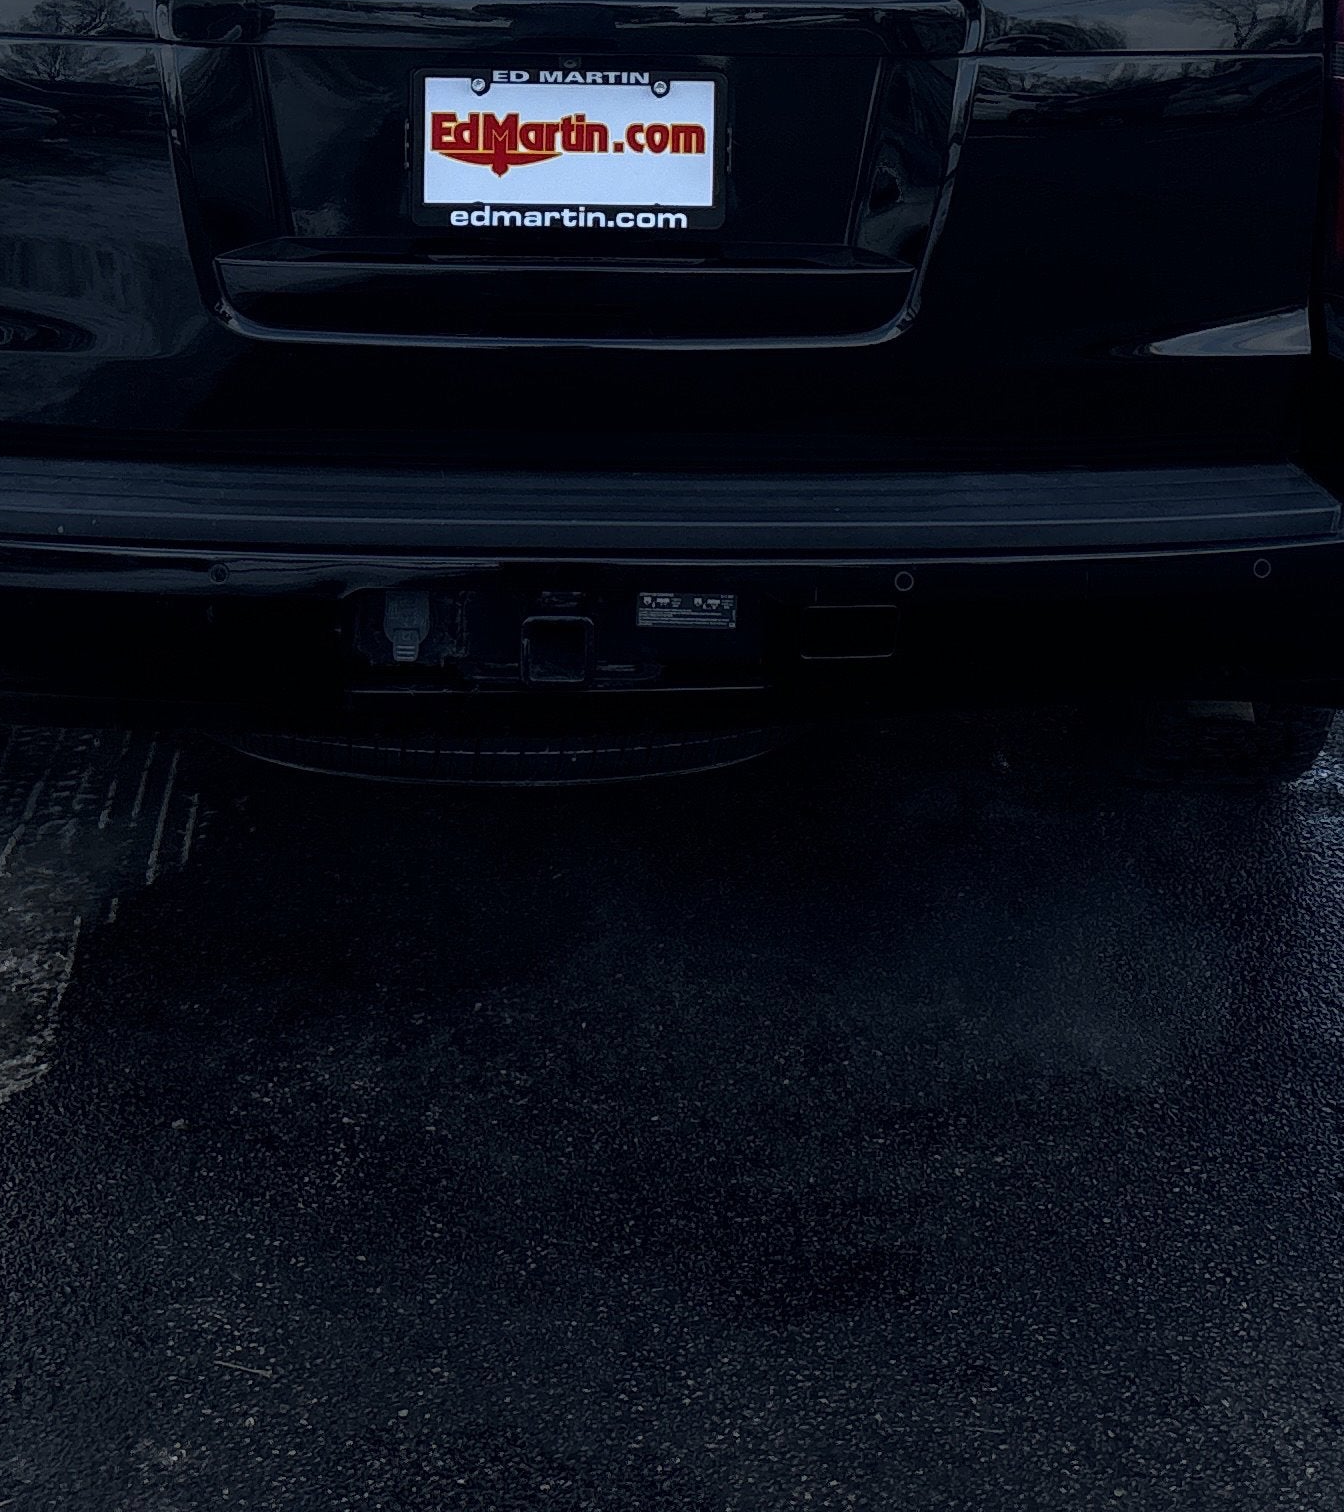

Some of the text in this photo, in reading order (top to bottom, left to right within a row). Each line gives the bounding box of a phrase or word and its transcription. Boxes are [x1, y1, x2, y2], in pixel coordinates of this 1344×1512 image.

[492, 70, 650, 85] ED MARTIN
[449, 206, 689, 229] edmartin.com
